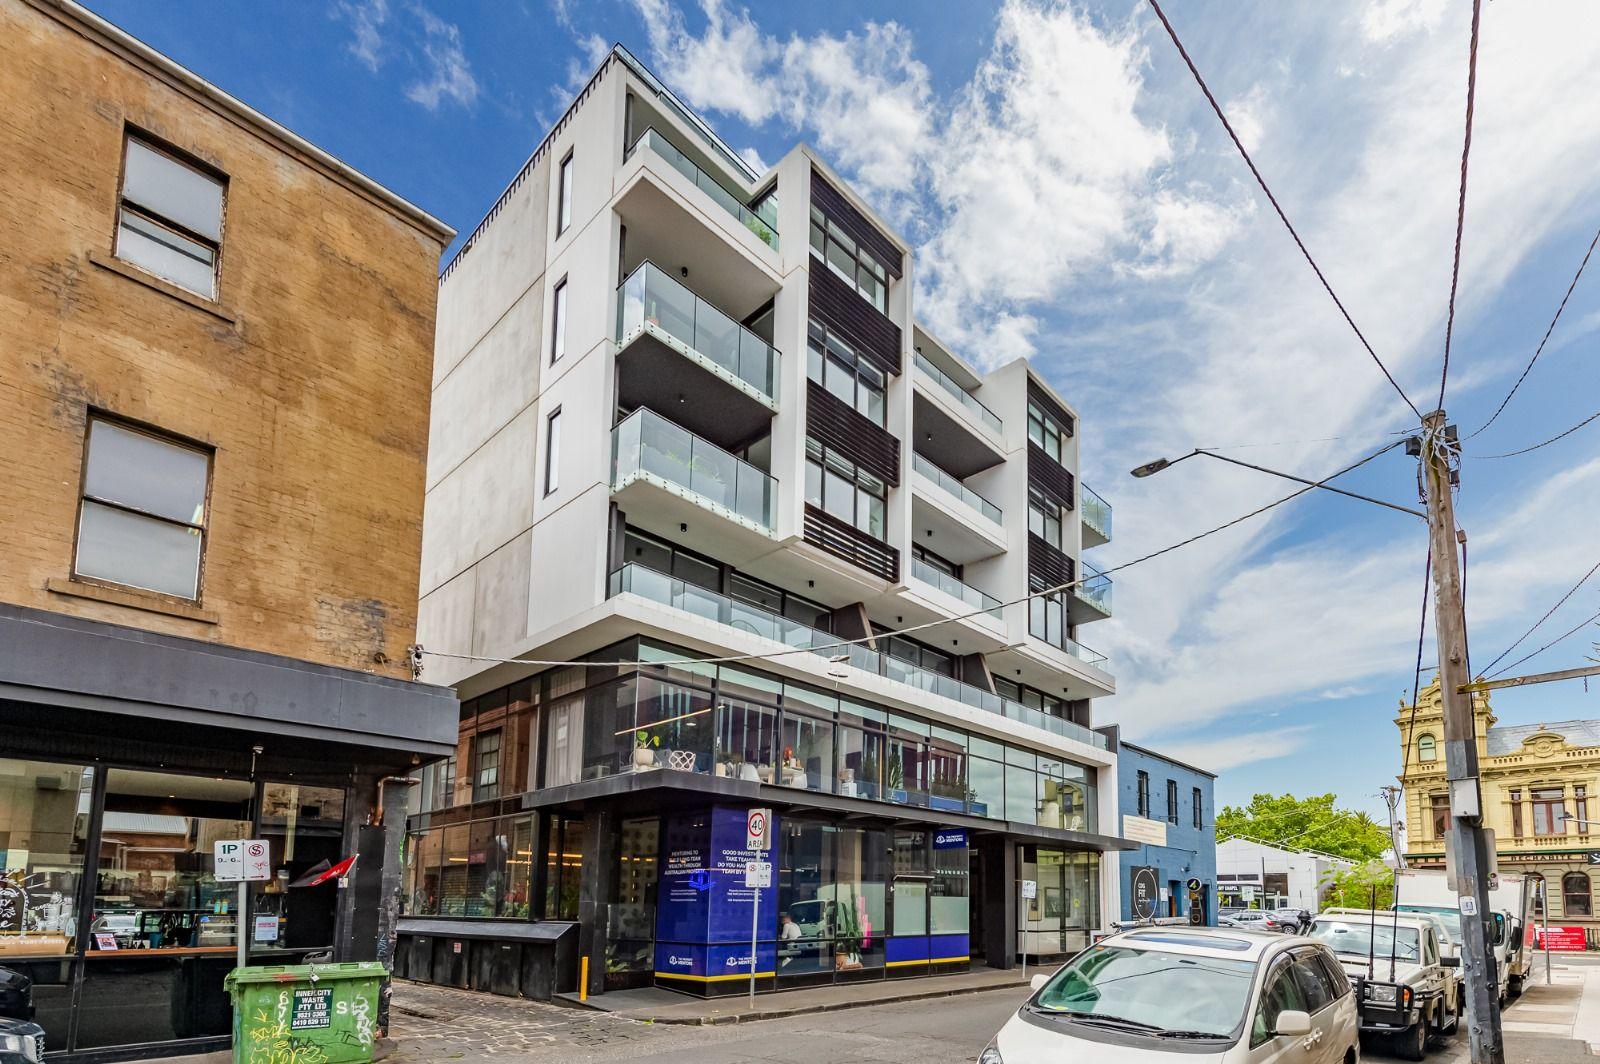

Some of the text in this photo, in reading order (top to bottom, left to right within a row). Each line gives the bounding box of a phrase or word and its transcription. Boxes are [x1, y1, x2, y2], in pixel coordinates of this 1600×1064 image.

[751, 819, 763, 831] 40
[221, 844, 238, 854] 1P
[737, 850, 769, 858] INVESTMNTS
[302, 996, 324, 1004] WASTE
[314, 1002, 327, 1010] LTD
